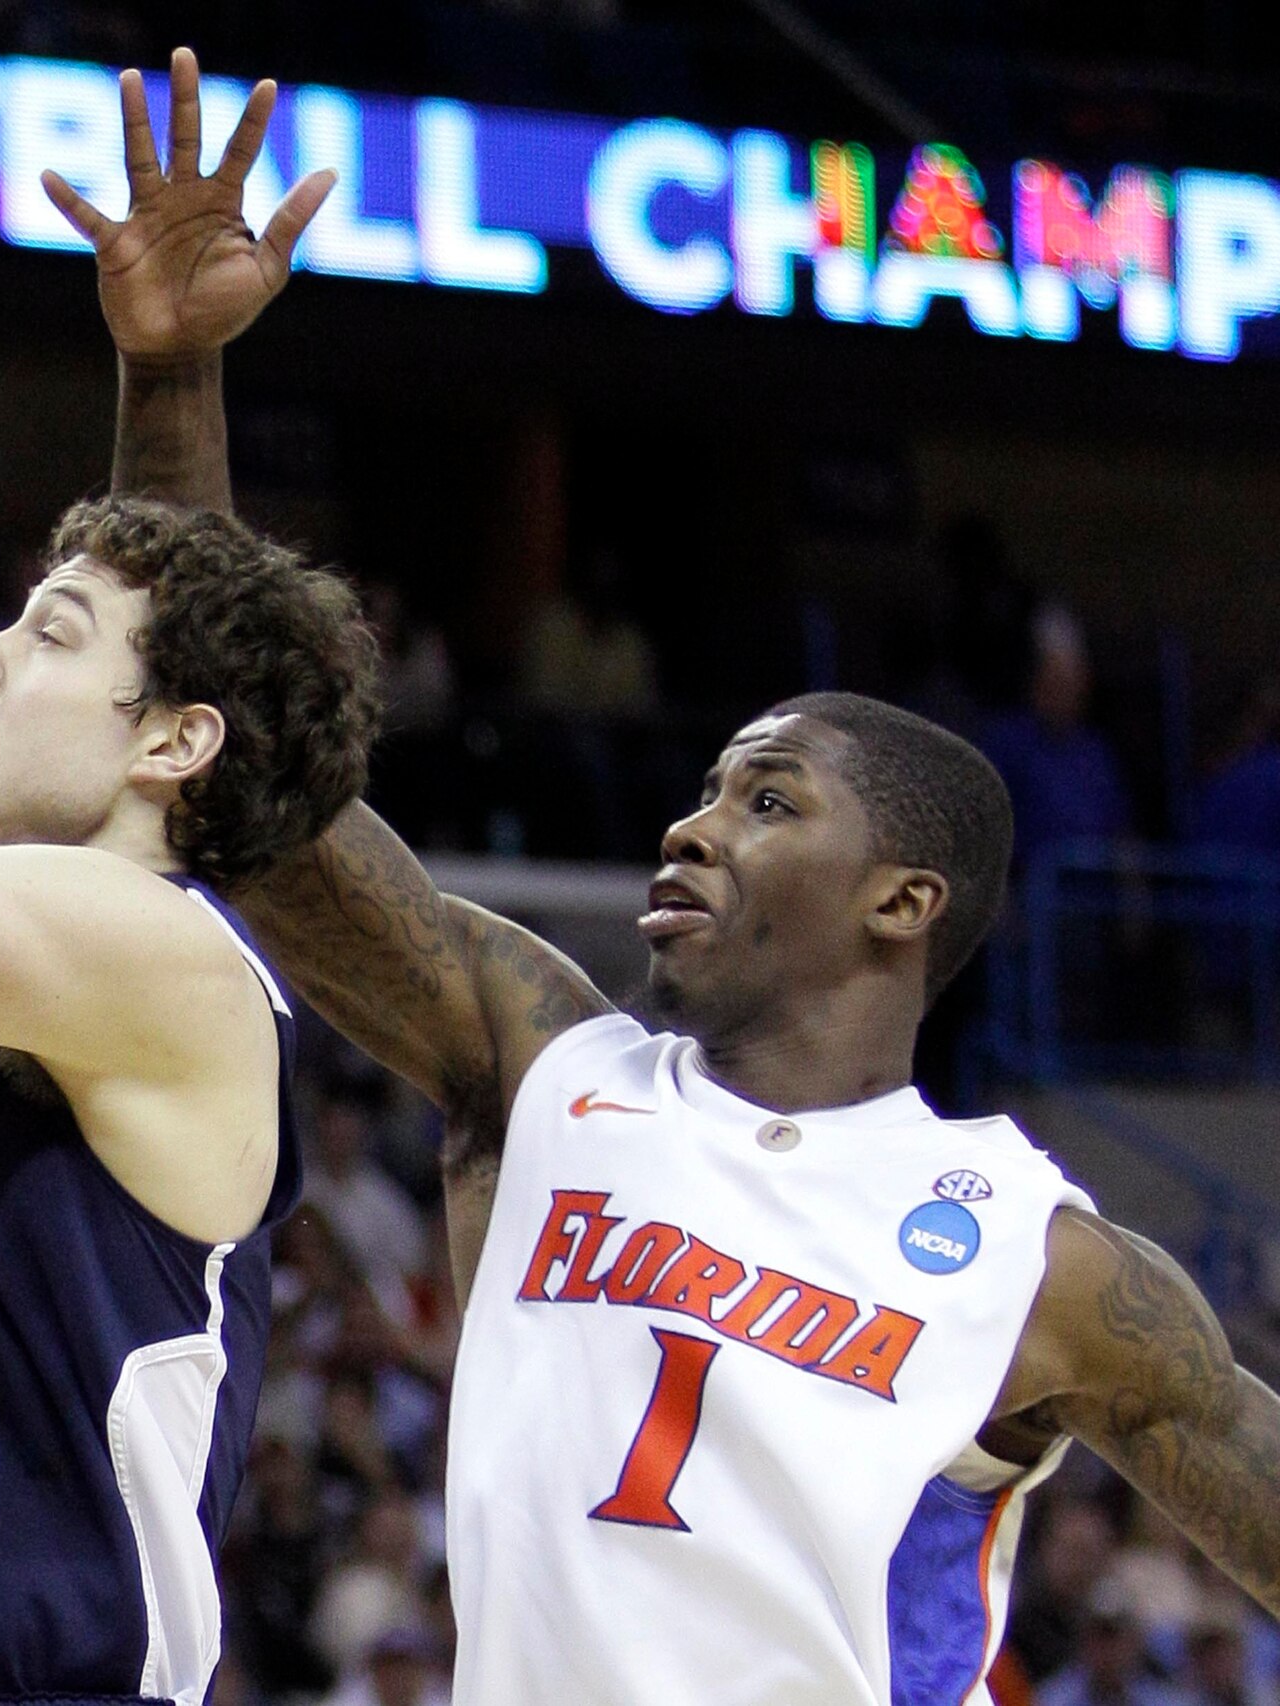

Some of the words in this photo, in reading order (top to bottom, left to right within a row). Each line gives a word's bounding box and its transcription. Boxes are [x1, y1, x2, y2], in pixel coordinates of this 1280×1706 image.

[516, 1189, 926, 1404] FLORIDA
[906, 1226, 968, 1263] NCAA
[587, 1326, 722, 1532] 1
